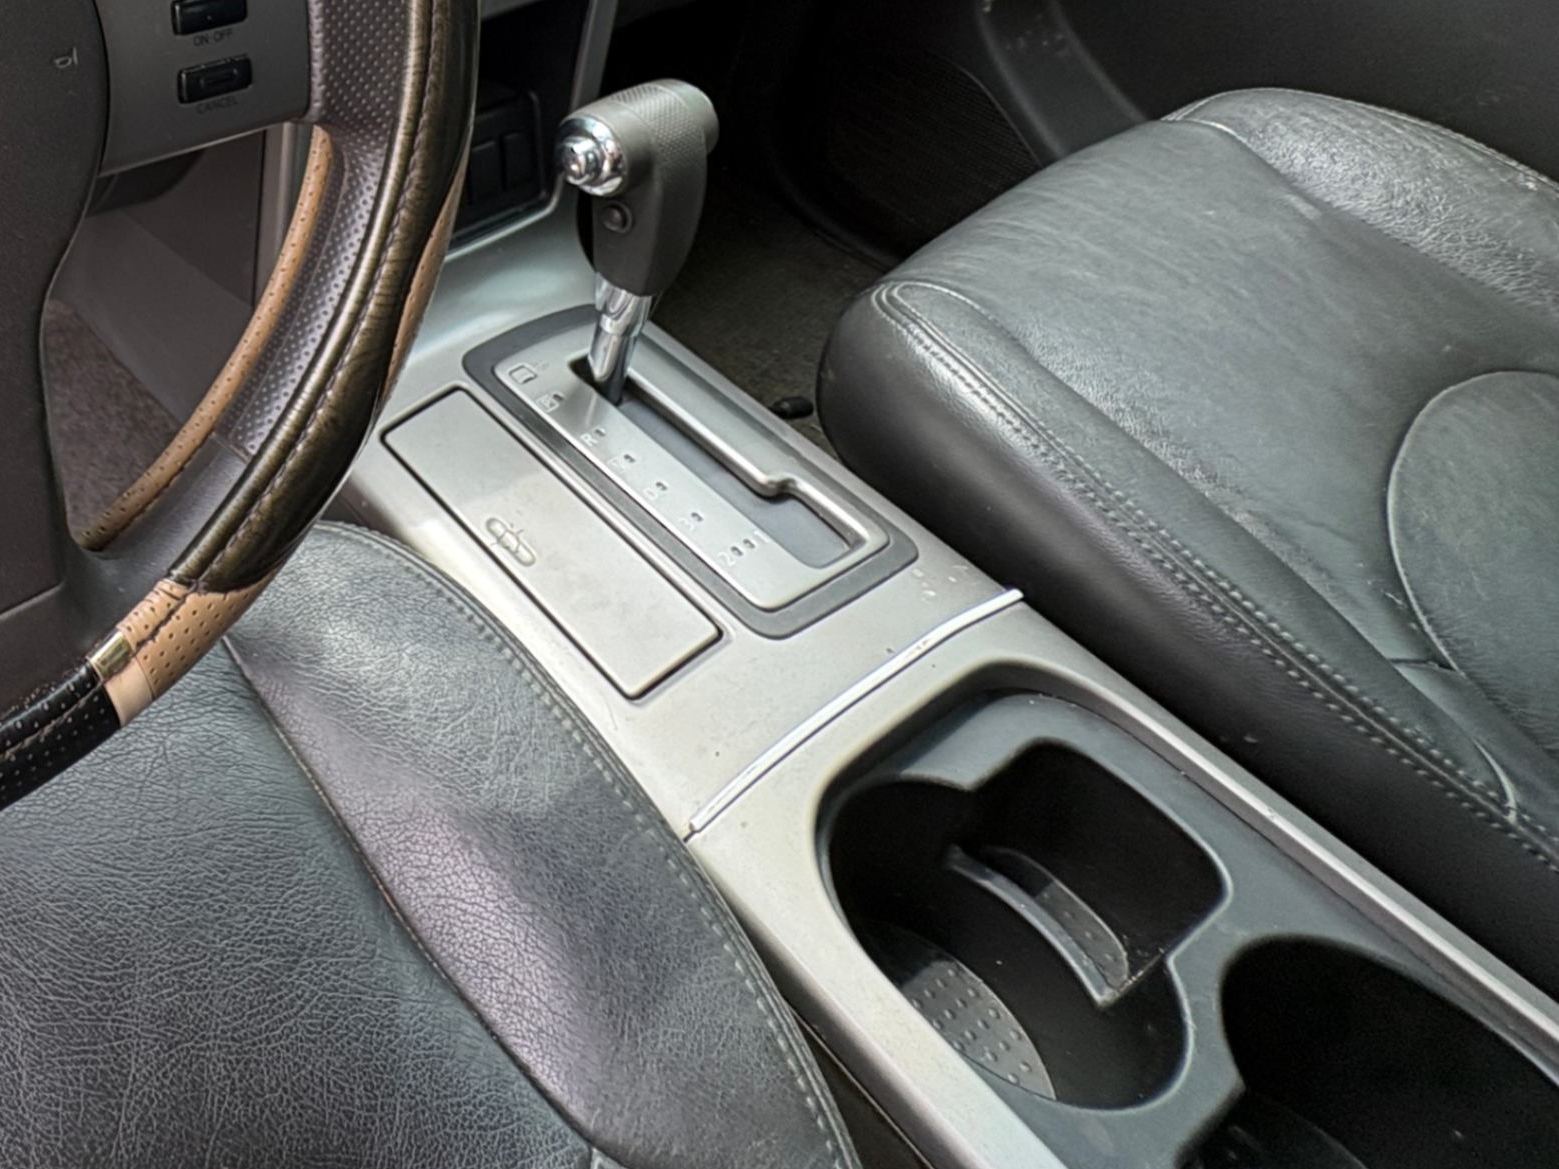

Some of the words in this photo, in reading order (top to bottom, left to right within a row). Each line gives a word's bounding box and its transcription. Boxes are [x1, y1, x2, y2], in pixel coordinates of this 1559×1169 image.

[195, 94, 240, 115] CANCEL
[580, 433, 598, 447] R
[642, 488, 658, 501] D
[718, 551, 736, 566] 2
